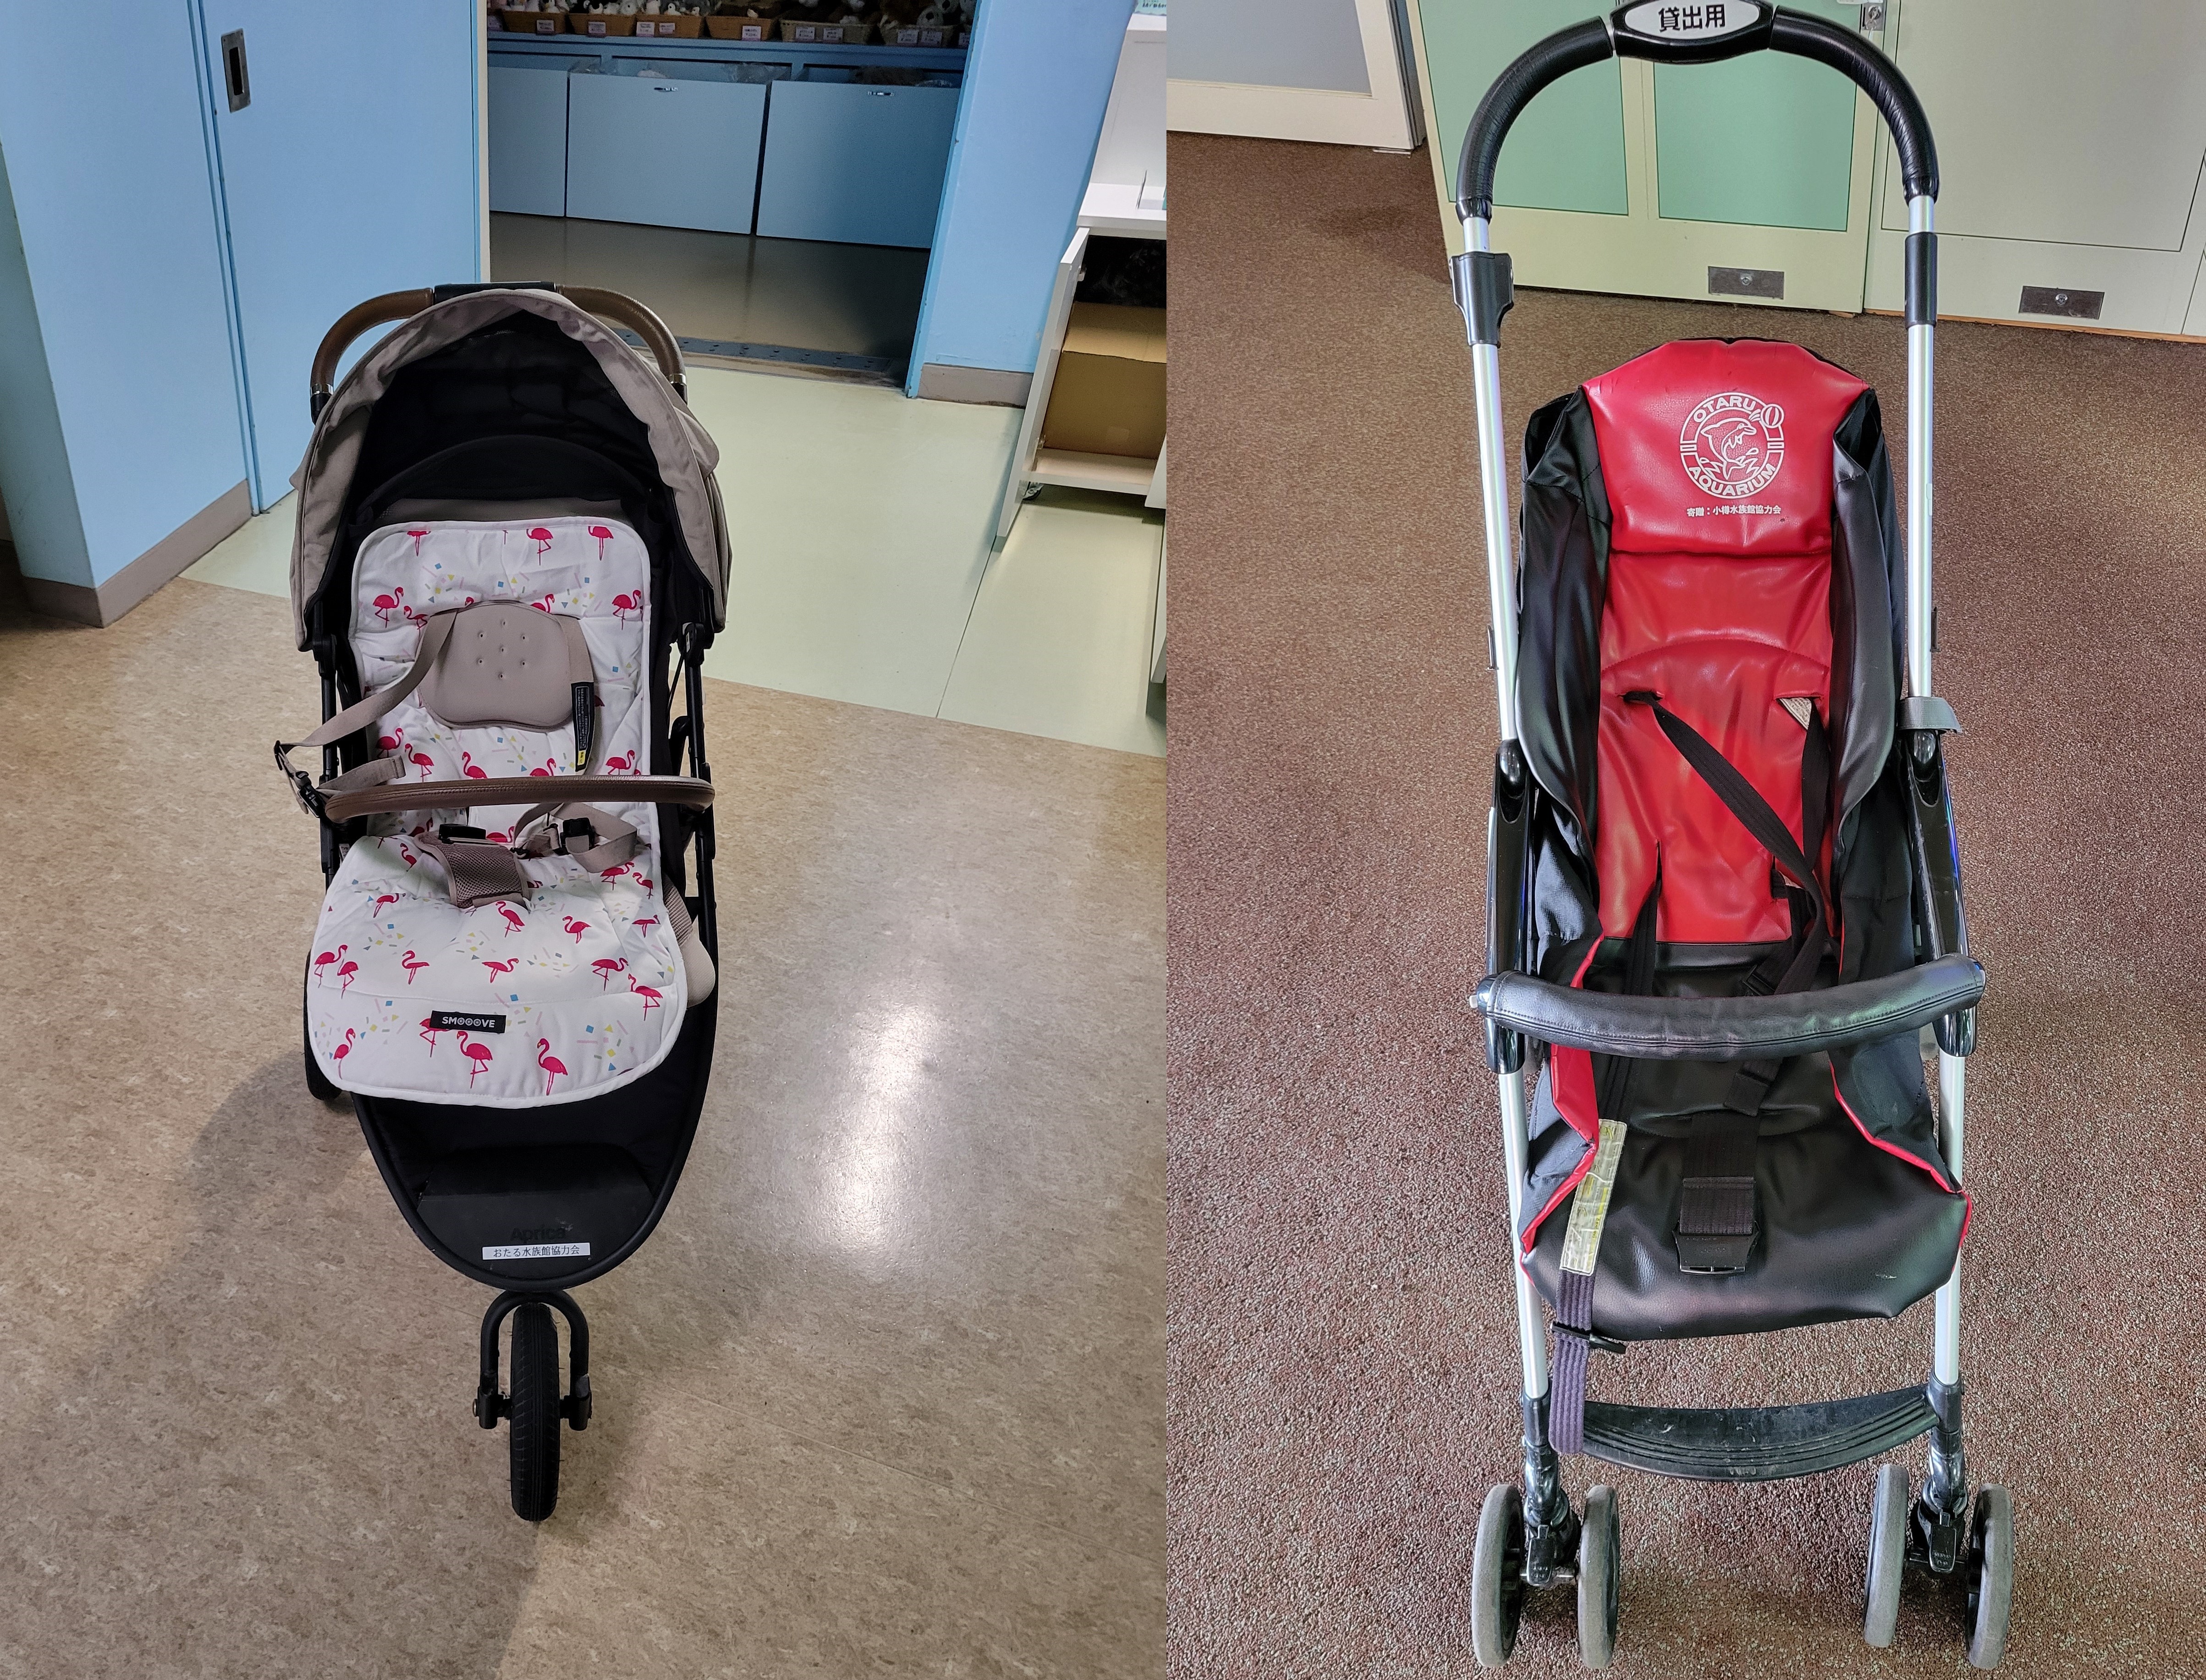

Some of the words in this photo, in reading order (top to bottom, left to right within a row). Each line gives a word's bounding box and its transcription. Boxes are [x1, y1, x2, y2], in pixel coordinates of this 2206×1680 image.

[1658, 4, 1726, 33] 貸出用
[1694, 396, 1756, 423] OTARU
[1689, 463, 1776, 496] AQUARIUM
[441, 1016, 495, 1028] SMOOOVE
[493, 1245, 580, 1257] おたる水族館協力会
